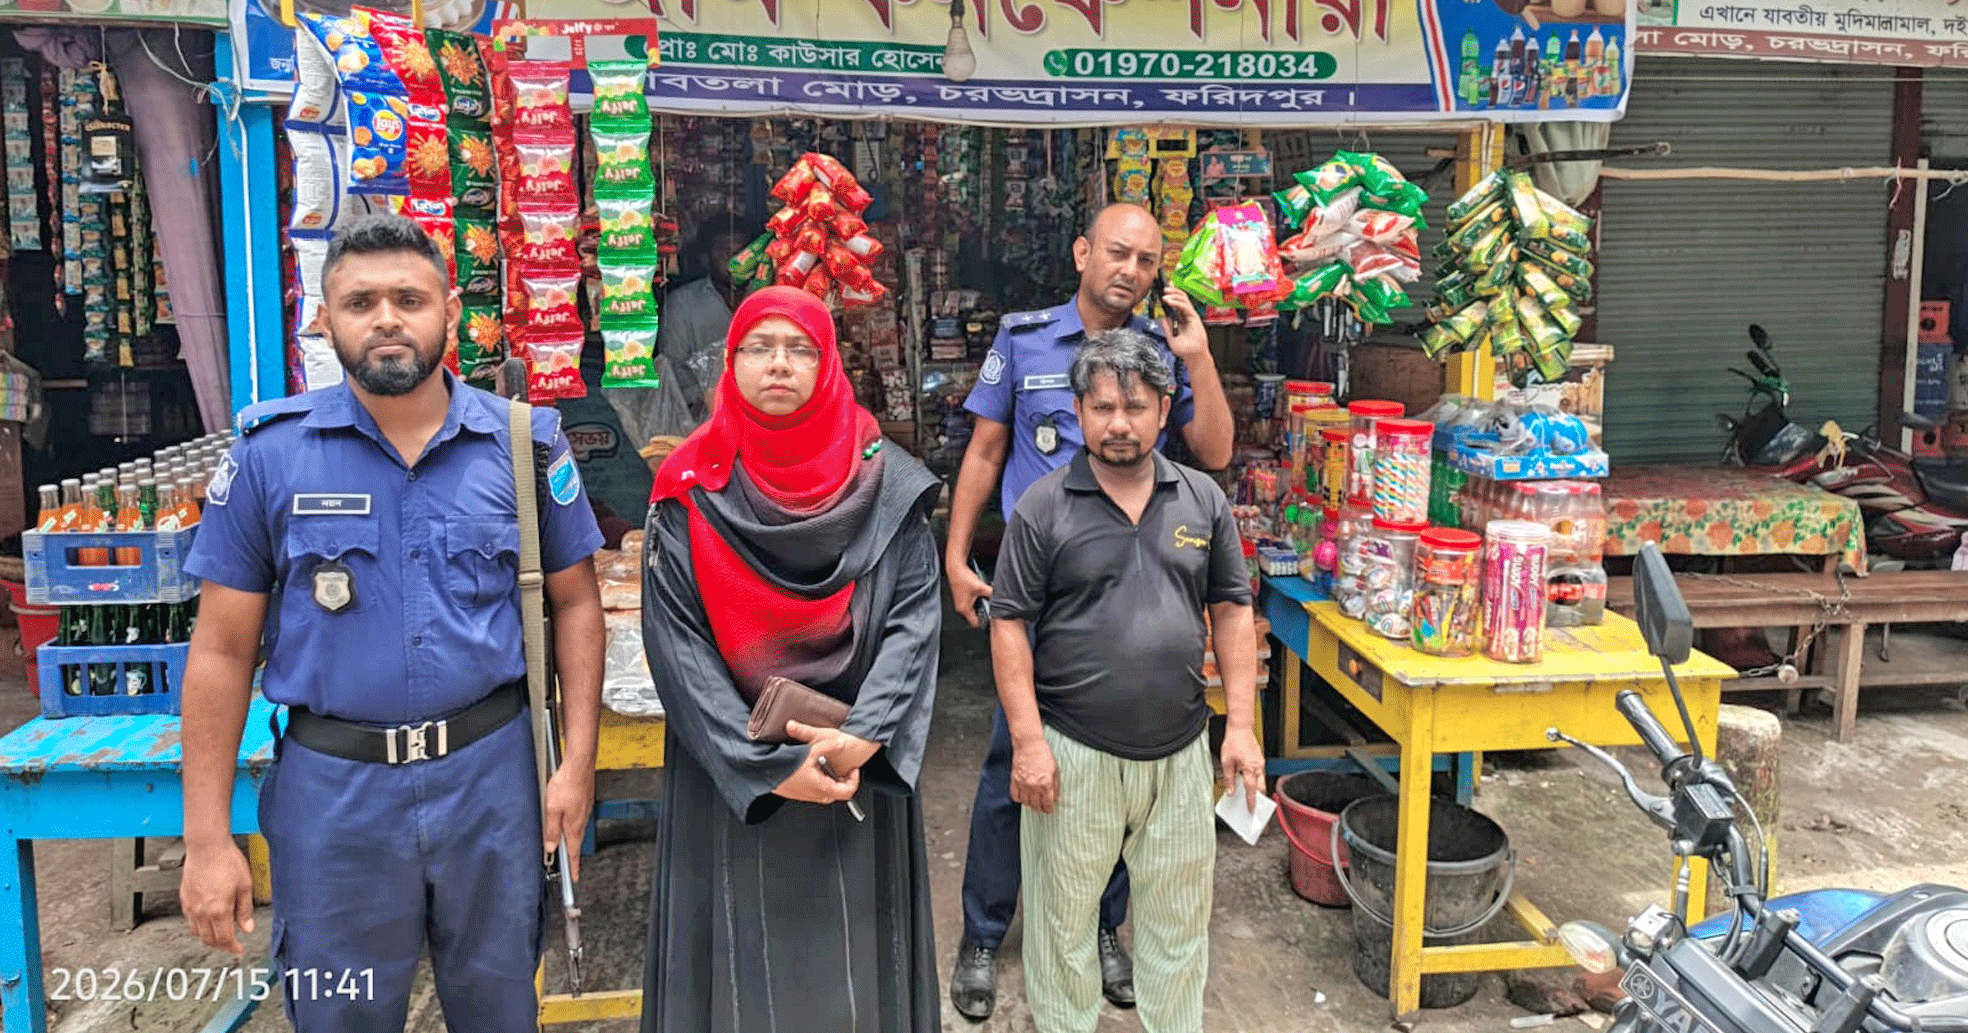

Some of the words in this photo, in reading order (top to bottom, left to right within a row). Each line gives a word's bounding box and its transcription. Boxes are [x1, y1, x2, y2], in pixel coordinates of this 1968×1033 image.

[1700, 6, 1757, 24] এখানে
[1763, 5, 1827, 27] যাবতীয়
[708, 41, 759, 63] মোঃ
[766, 40, 863, 69] কাউসার
[1674, 30, 1754, 51] মোড়,
[1767, 34, 1913, 60] চরভদ্রাসন,
[1074, 51, 1319, 77] 01970-218034
[645, 70, 784, 97] াবতলা
[802, 79, 917, 103] মোড়,
[934, 83, 1144, 110] চরভদ্রাসন,
[1159, 84, 1327, 110] ফরিদপুর
[1653, 988, 1712, 1033] YA
